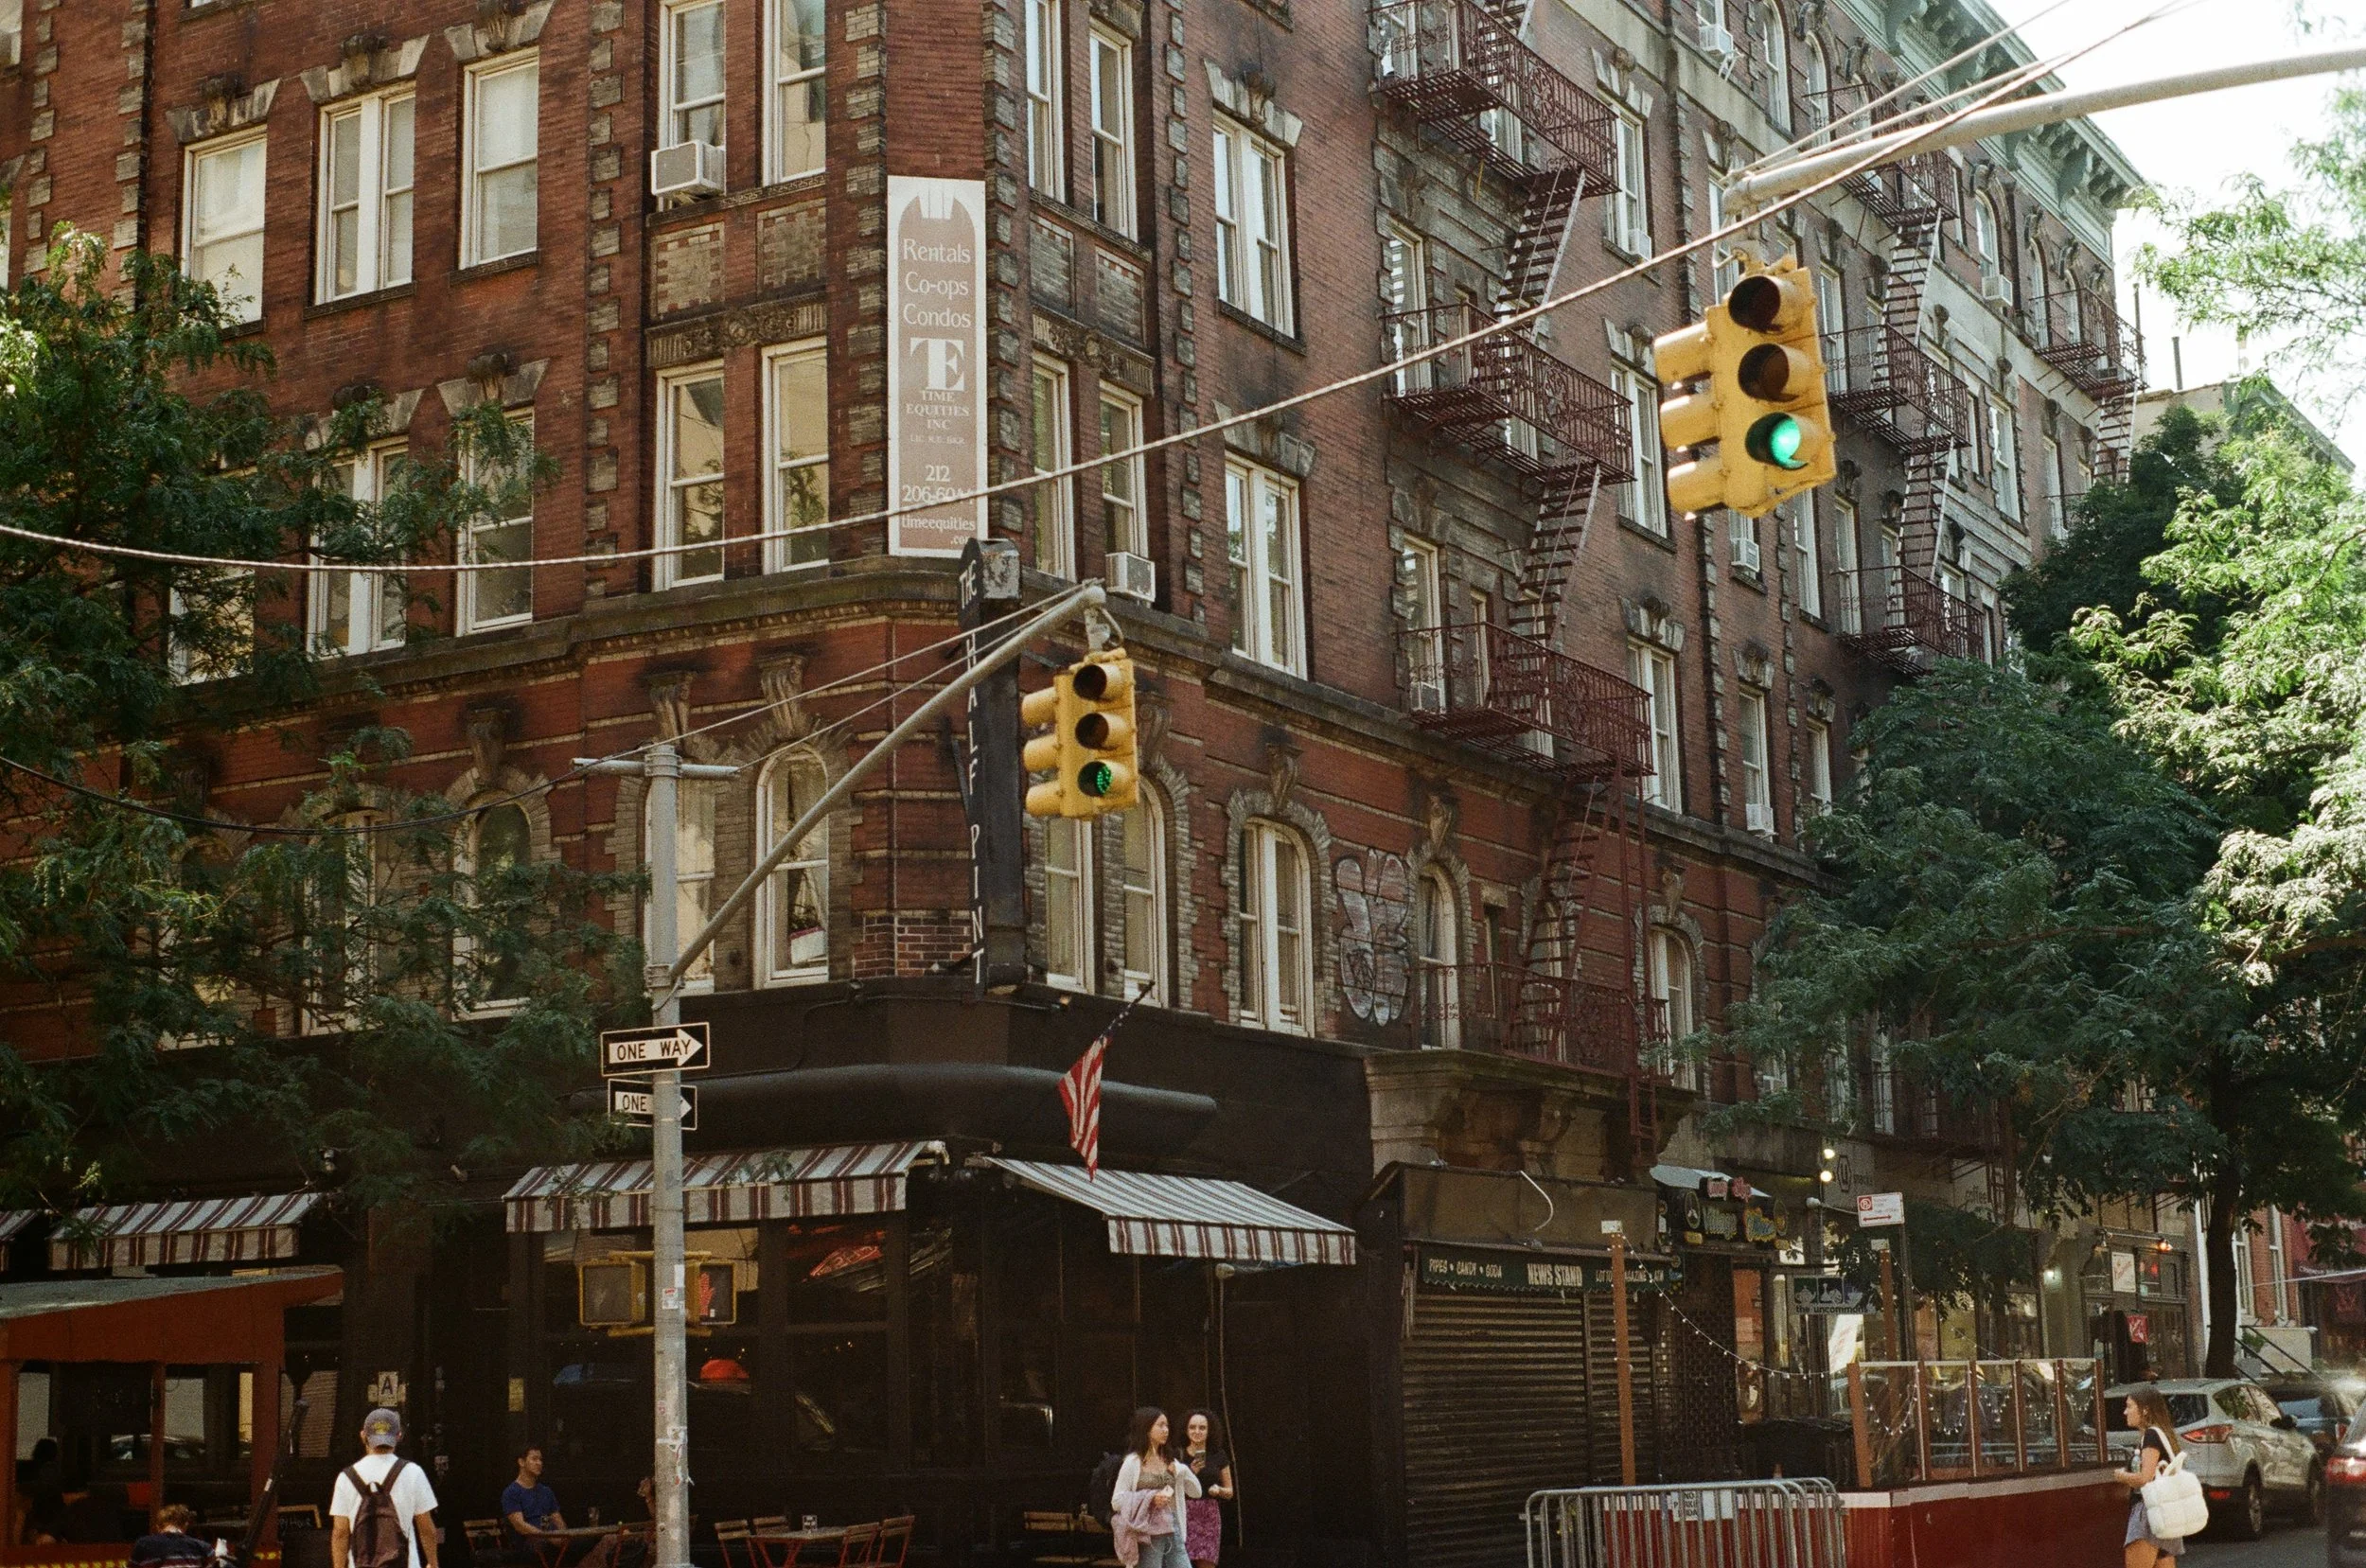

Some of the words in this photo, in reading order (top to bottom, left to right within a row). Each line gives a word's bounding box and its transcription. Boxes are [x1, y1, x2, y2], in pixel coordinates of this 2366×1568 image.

[903, 238, 971, 264] Rentals
[905, 271, 969, 299] Co-ops
[903, 303, 971, 328] Condos
[920, 390, 955, 402] TIME
[906, 403, 970, 417] EQUITIES
[927, 419, 951, 430] INC
[925, 465, 950, 483] 212
[902, 514, 976, 532] timeequities
[959, 559, 977, 610] THE
[970, 823, 984, 985] PINT
[617, 1043, 646, 1061] ONE
[660, 1039, 692, 1057] WAY
[622, 1094, 647, 1112] ONE
[1527, 1263, 1553, 1286] NEWS
[1554, 1264, 1583, 1287] STAND
[1795, 1305, 1810, 1313] the
[381, 1376, 393, 1395] A
